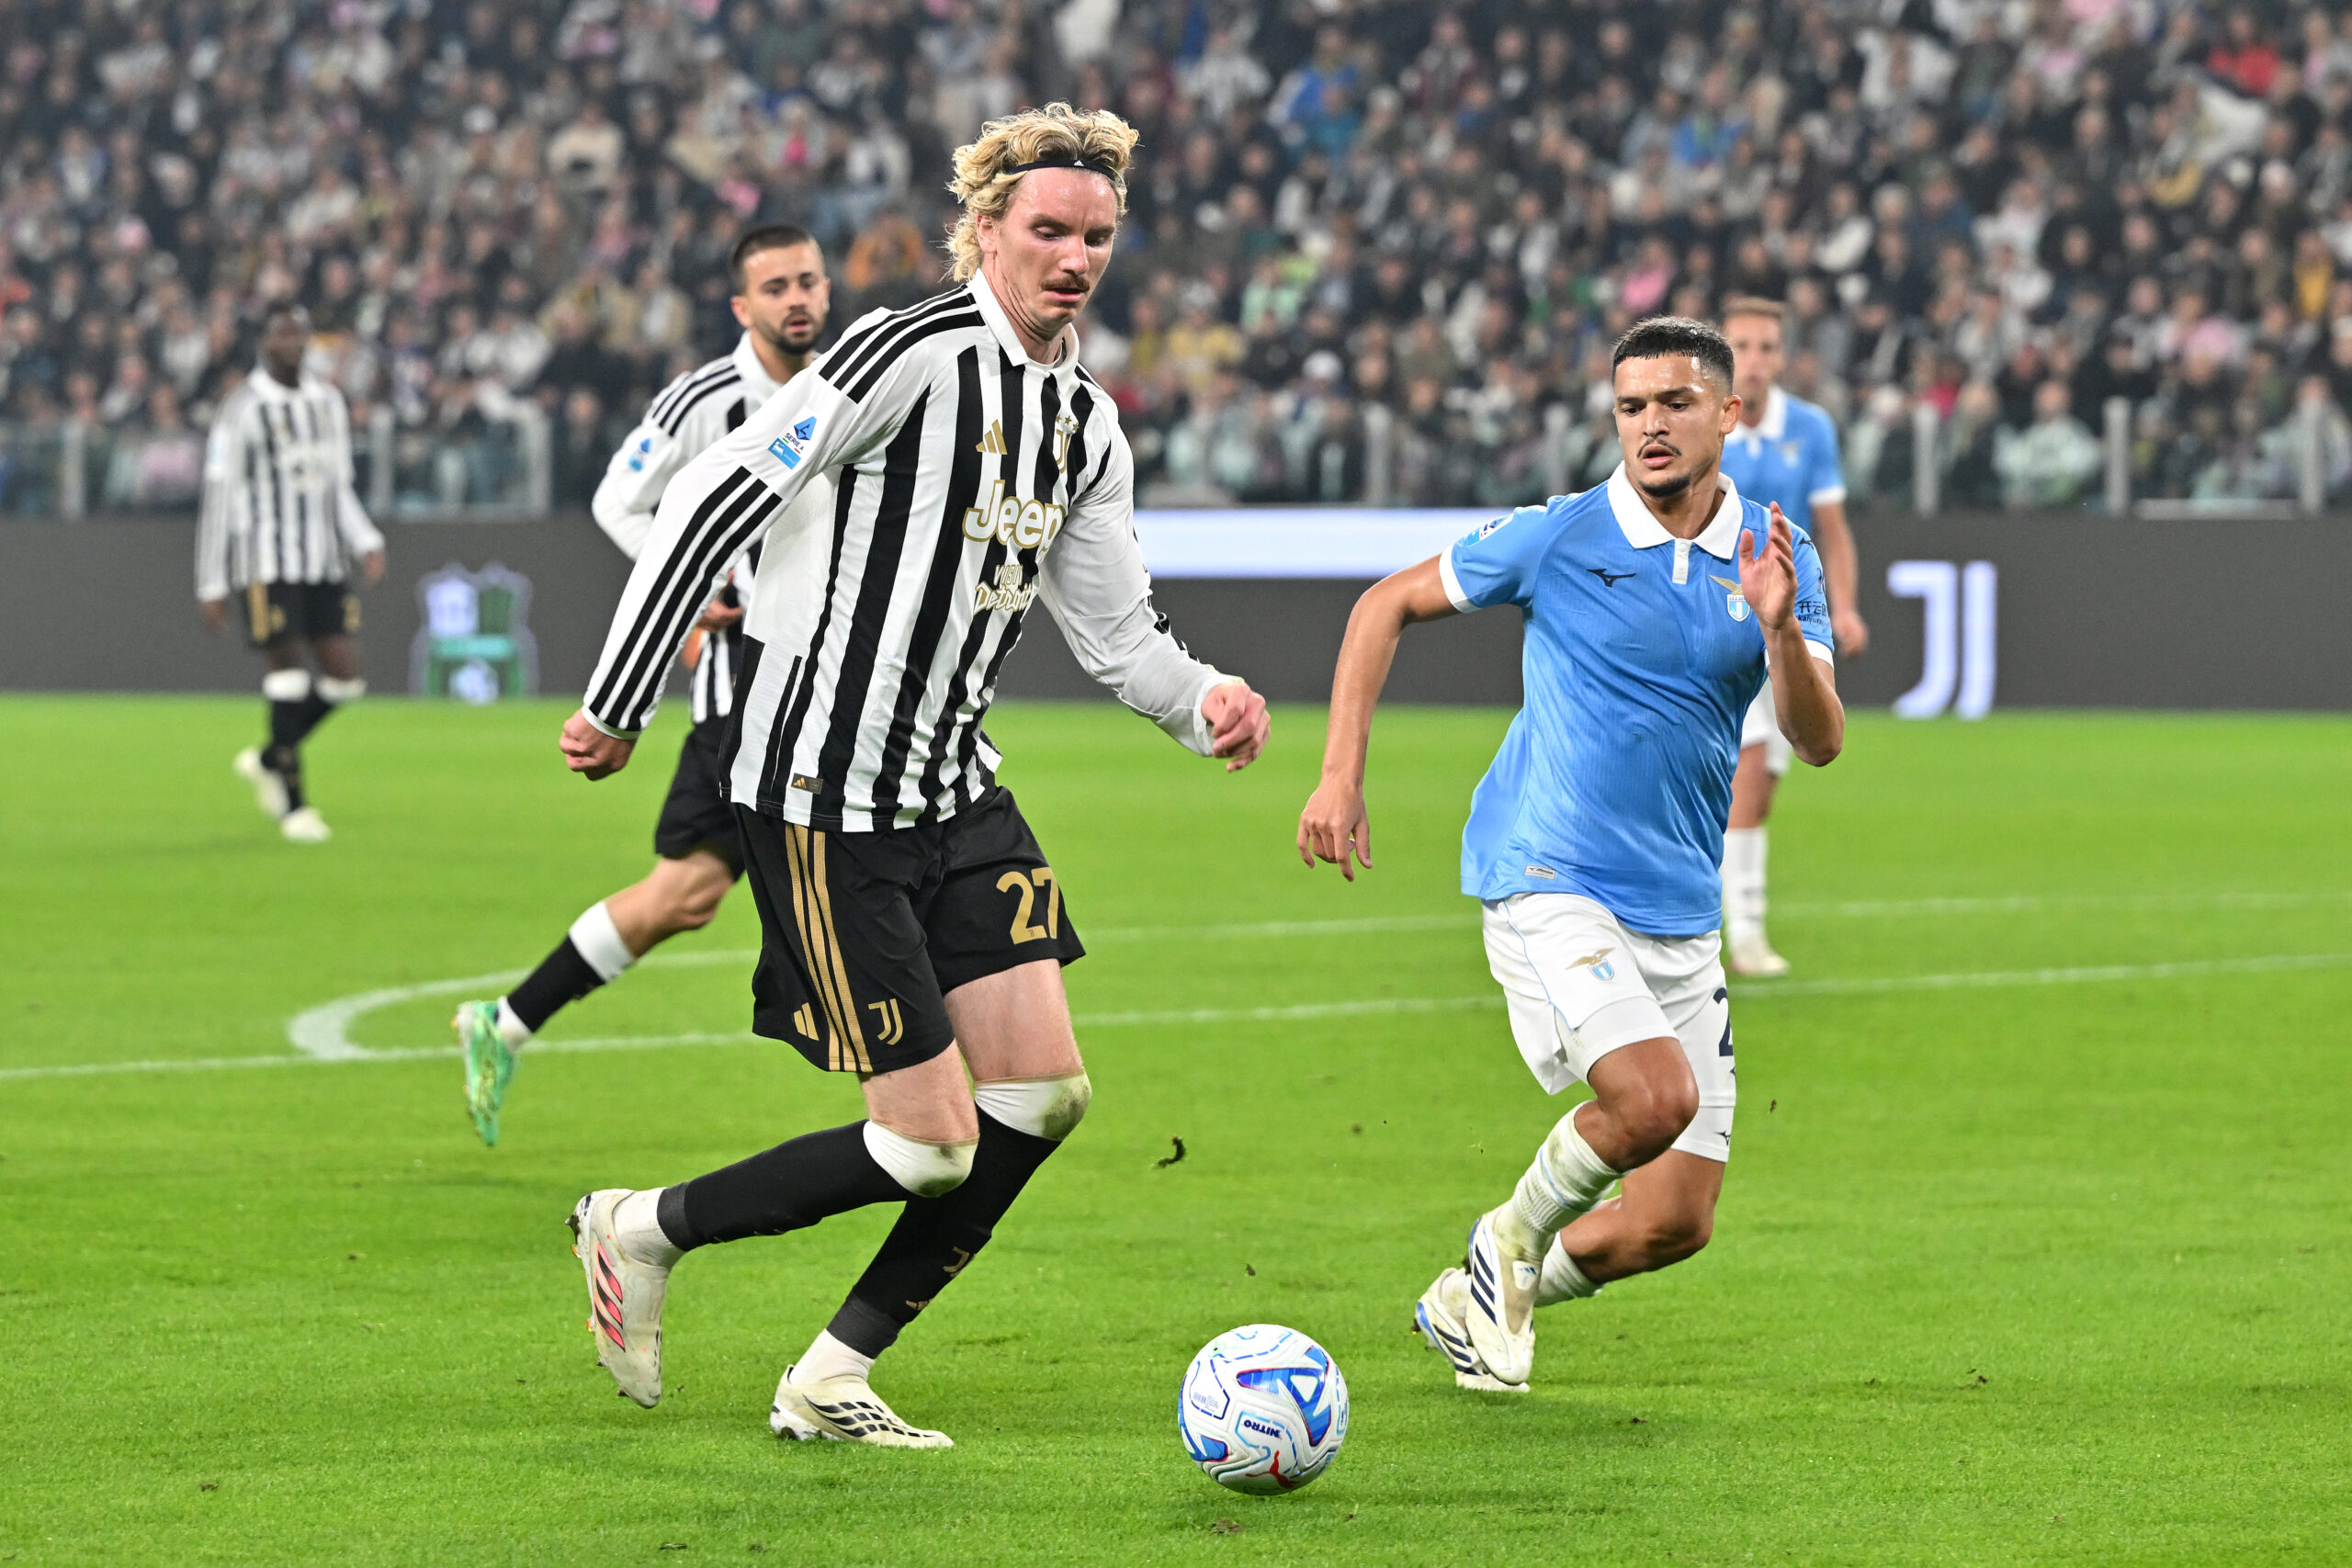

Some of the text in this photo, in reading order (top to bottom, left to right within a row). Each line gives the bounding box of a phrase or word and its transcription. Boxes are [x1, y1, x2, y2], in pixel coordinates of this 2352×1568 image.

[785, 433, 801, 447] SERIE
[962, 479, 1066, 555] Jeep
[996, 866, 1059, 945] 27
[1243, 1419, 1282, 1438] NITRO
